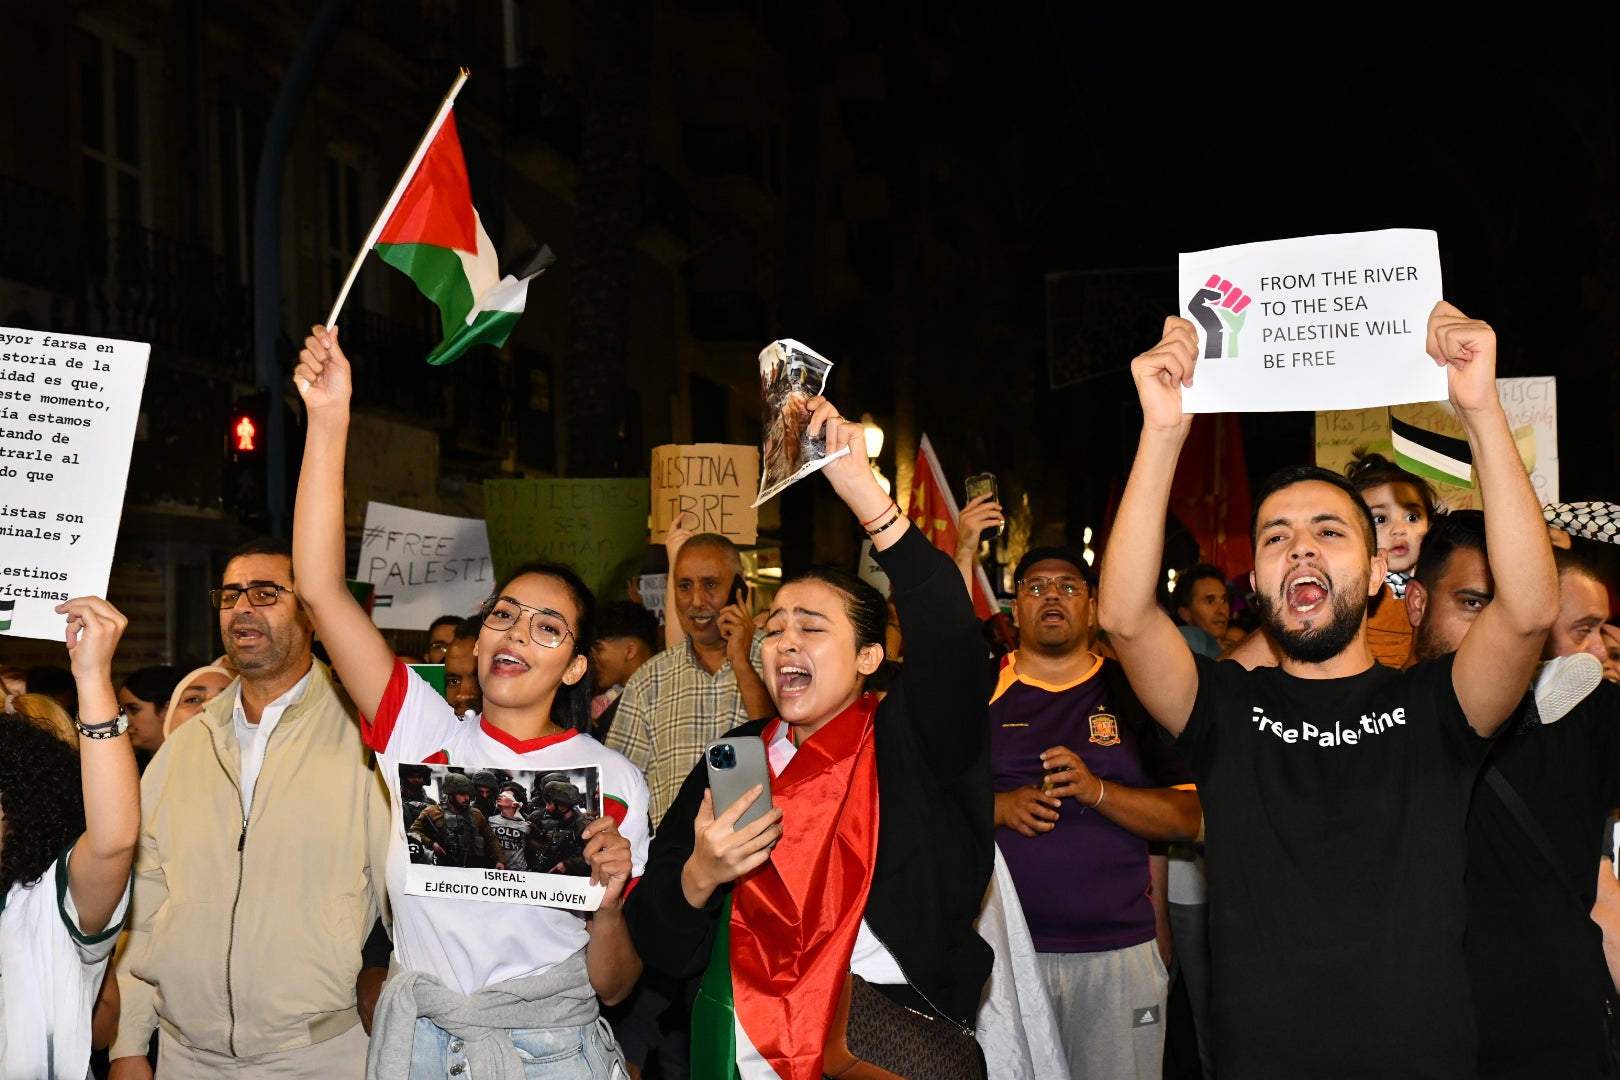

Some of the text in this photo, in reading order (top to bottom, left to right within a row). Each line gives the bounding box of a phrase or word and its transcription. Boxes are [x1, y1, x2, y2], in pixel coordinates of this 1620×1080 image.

[1260, 267, 1418, 292] FROM THE RIVER
[1260, 296, 1369, 317] TO THE SEA
[1262, 319, 1412, 343] PALESTINE WILL
[42, 336, 87, 351] farsa
[96, 345, 114, 354] en
[65, 358, 84, 369] de
[92, 360, 111, 372] la
[1263, 351, 1336, 369] BE FREE
[44, 377, 62, 386] es
[70, 380, 104, 393] que,
[40, 395, 110, 412] momento,
[28, 414, 91, 428] estamos
[51, 433, 70, 445] de
[61, 454, 80, 465] al
[26, 472, 54, 483] que
[0, 505, 84, 524] istas son
[69, 535, 81, 546] y
[362, 524, 455, 557] #FREE
[0, 567, 68, 582] estinos
[368, 555, 490, 587] PALESTI
[484, 871, 526, 883] ISREAL:
[425, 881, 587, 905] EJÉRCITO CONTRA UN JÓVEN
